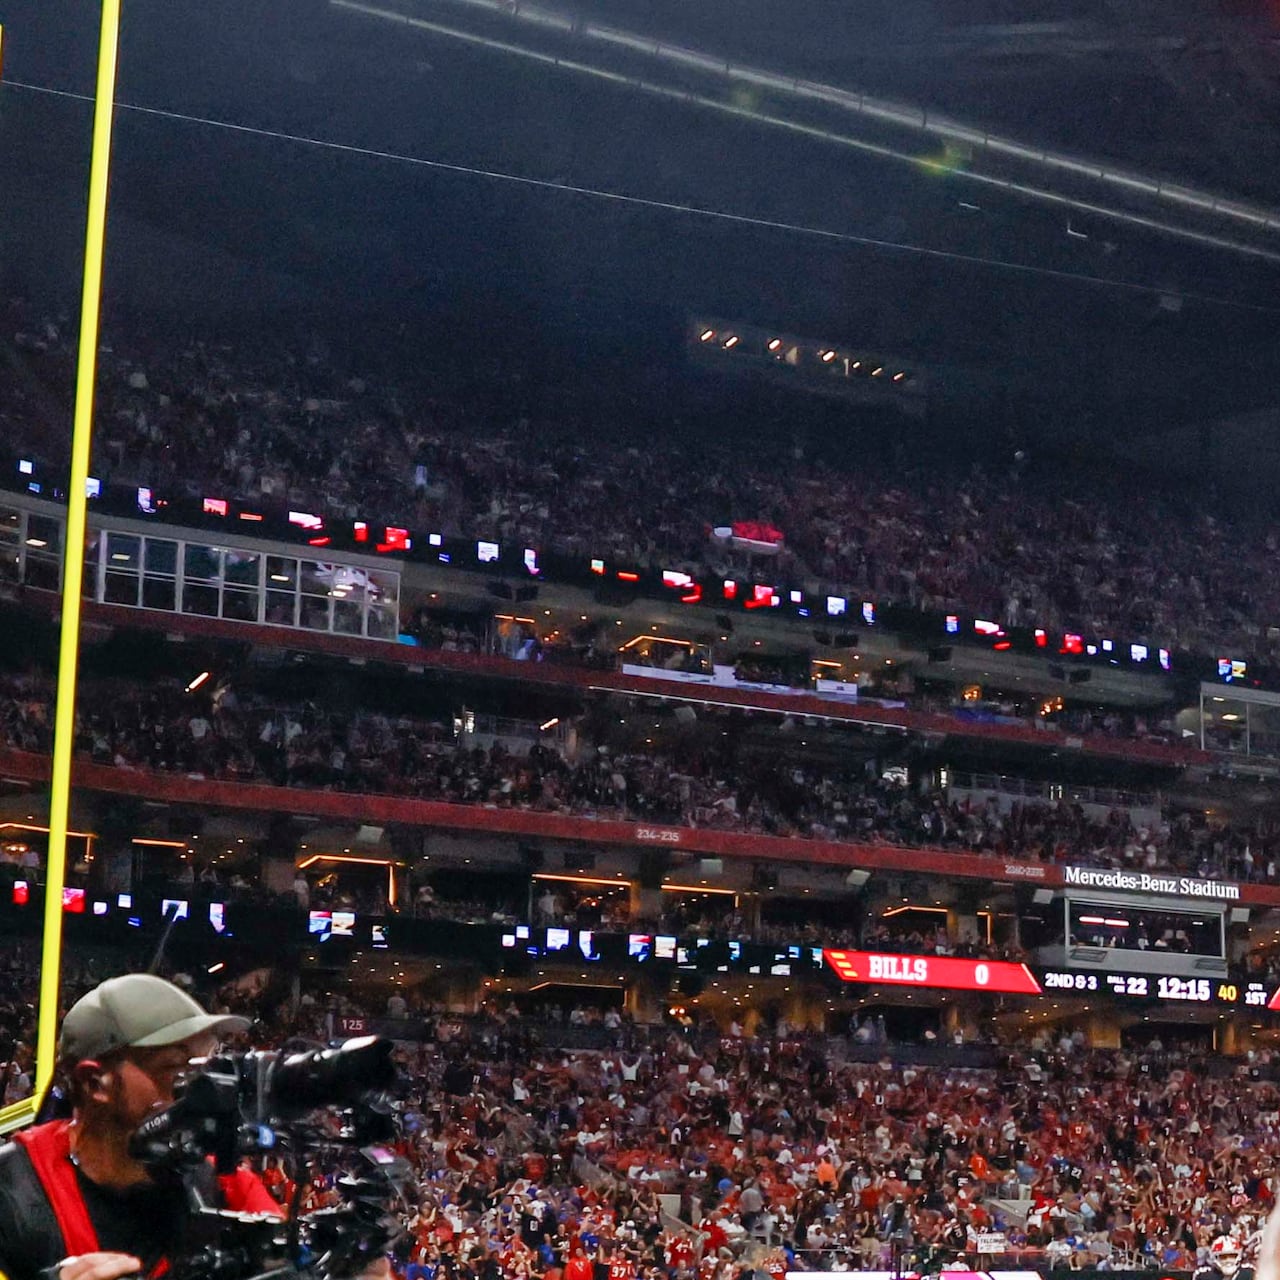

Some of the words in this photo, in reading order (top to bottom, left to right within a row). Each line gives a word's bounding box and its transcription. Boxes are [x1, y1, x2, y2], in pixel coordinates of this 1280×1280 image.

[1064, 866, 1177, 894] Mercedes-Benz
[1179, 878, 1240, 900] Stadium
[868, 955, 928, 981] BILLS
[974, 964, 990, 985] 0
[1045, 972, 1073, 989] 2ND
[1075, 974, 1086, 989] &
[1087, 975, 1098, 990] 3
[1127, 977, 1148, 996] 22
[1157, 976, 1211, 1001] 12:15
[1218, 985, 1237, 1001] 40
[1245, 991, 1267, 1006] 1ST
[342, 1018, 363, 1031] 125
[611, 1266, 626, 1279] 97
